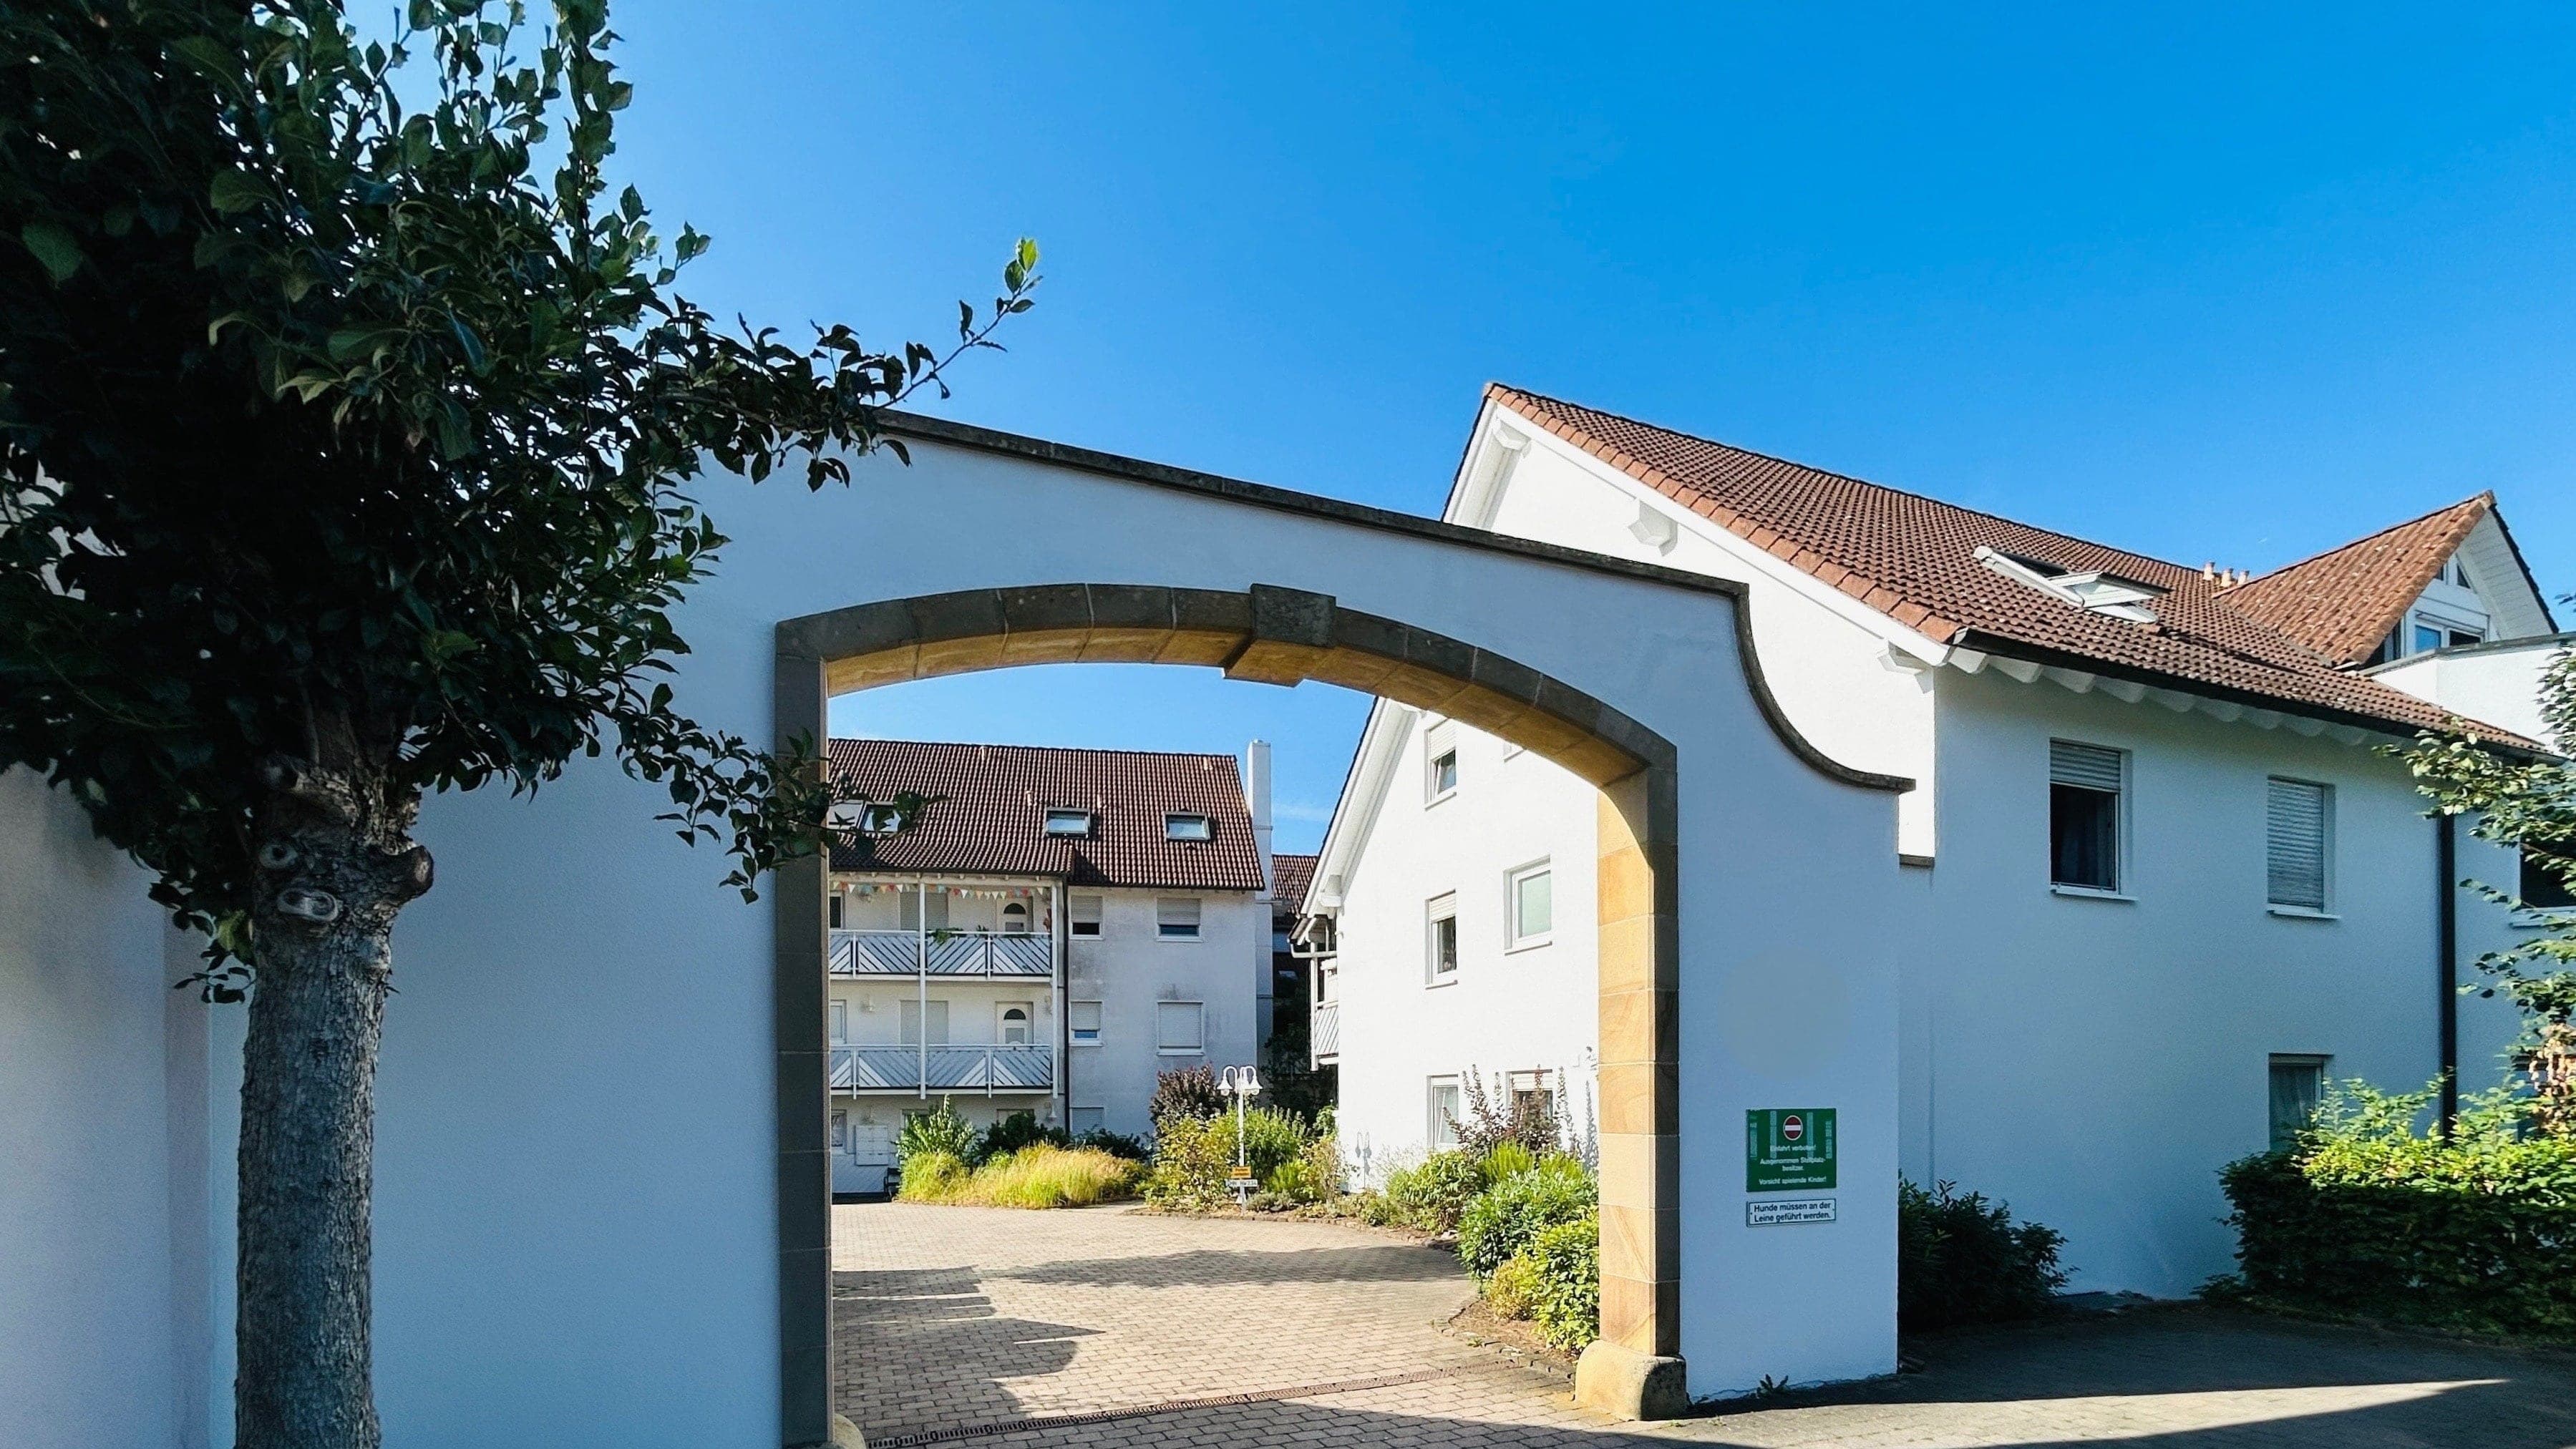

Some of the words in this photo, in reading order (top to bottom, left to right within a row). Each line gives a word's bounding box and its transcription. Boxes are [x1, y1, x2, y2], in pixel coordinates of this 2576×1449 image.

[1754, 1204, 1778, 1212] Hunde
[1779, 1203, 1807, 1211] müssen
[1776, 1213, 1802, 1223] geführt
